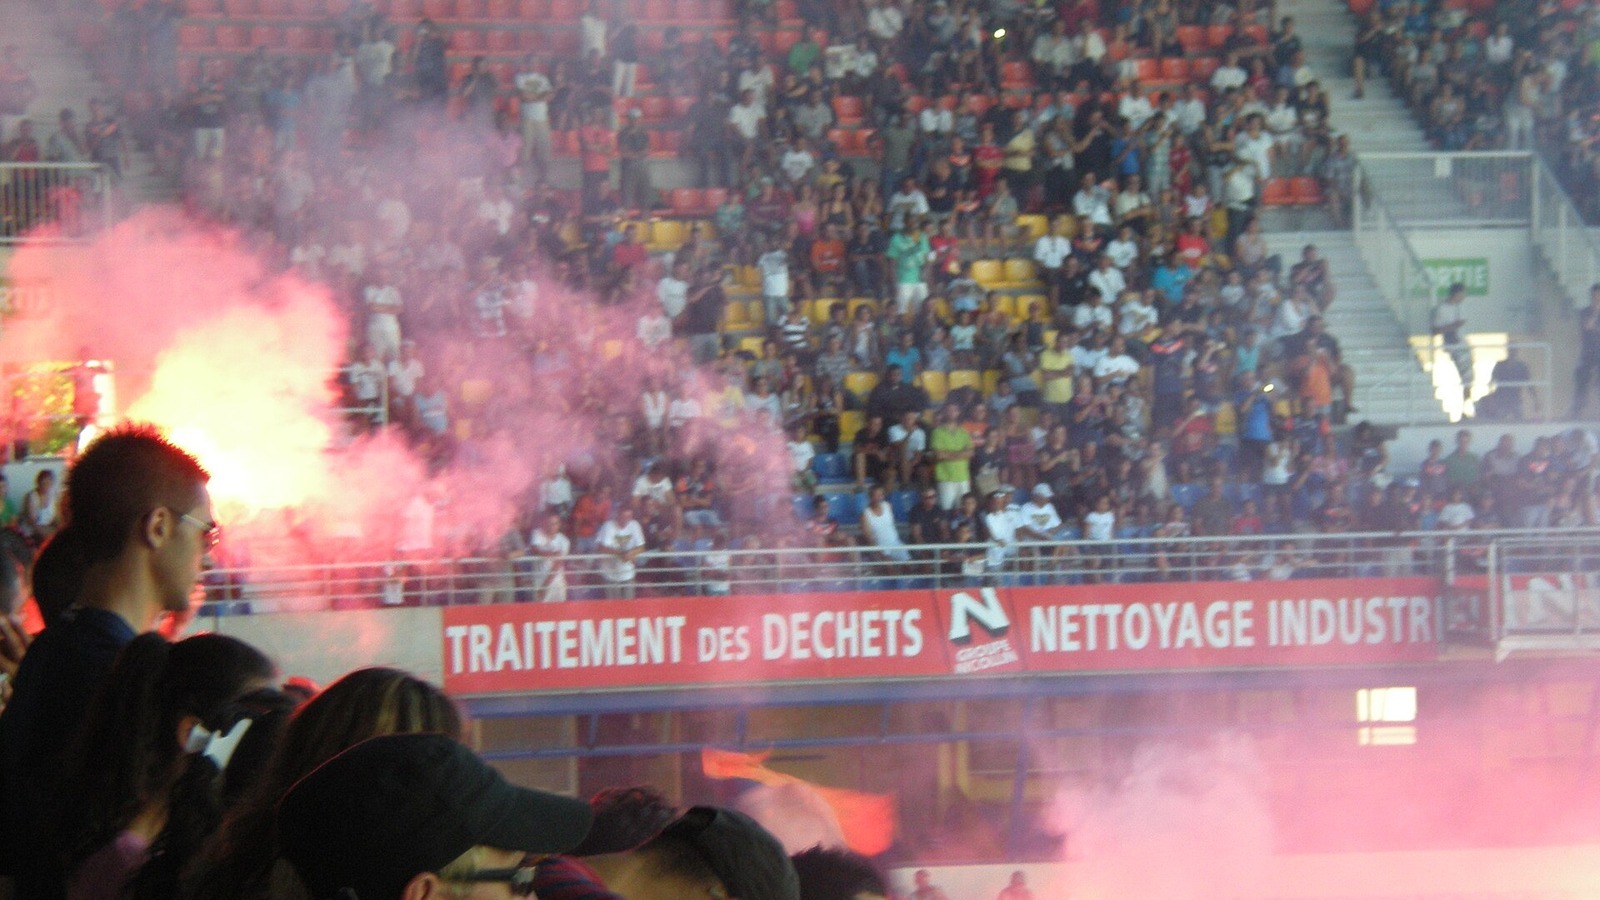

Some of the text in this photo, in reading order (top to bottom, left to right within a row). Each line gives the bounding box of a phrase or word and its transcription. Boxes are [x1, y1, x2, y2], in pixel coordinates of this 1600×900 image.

[446, 607, 924, 675] TRAITEMENT DES DECHETS
[948, 585, 1011, 646] N
[1030, 600, 1255, 653] NETTOYAGE
